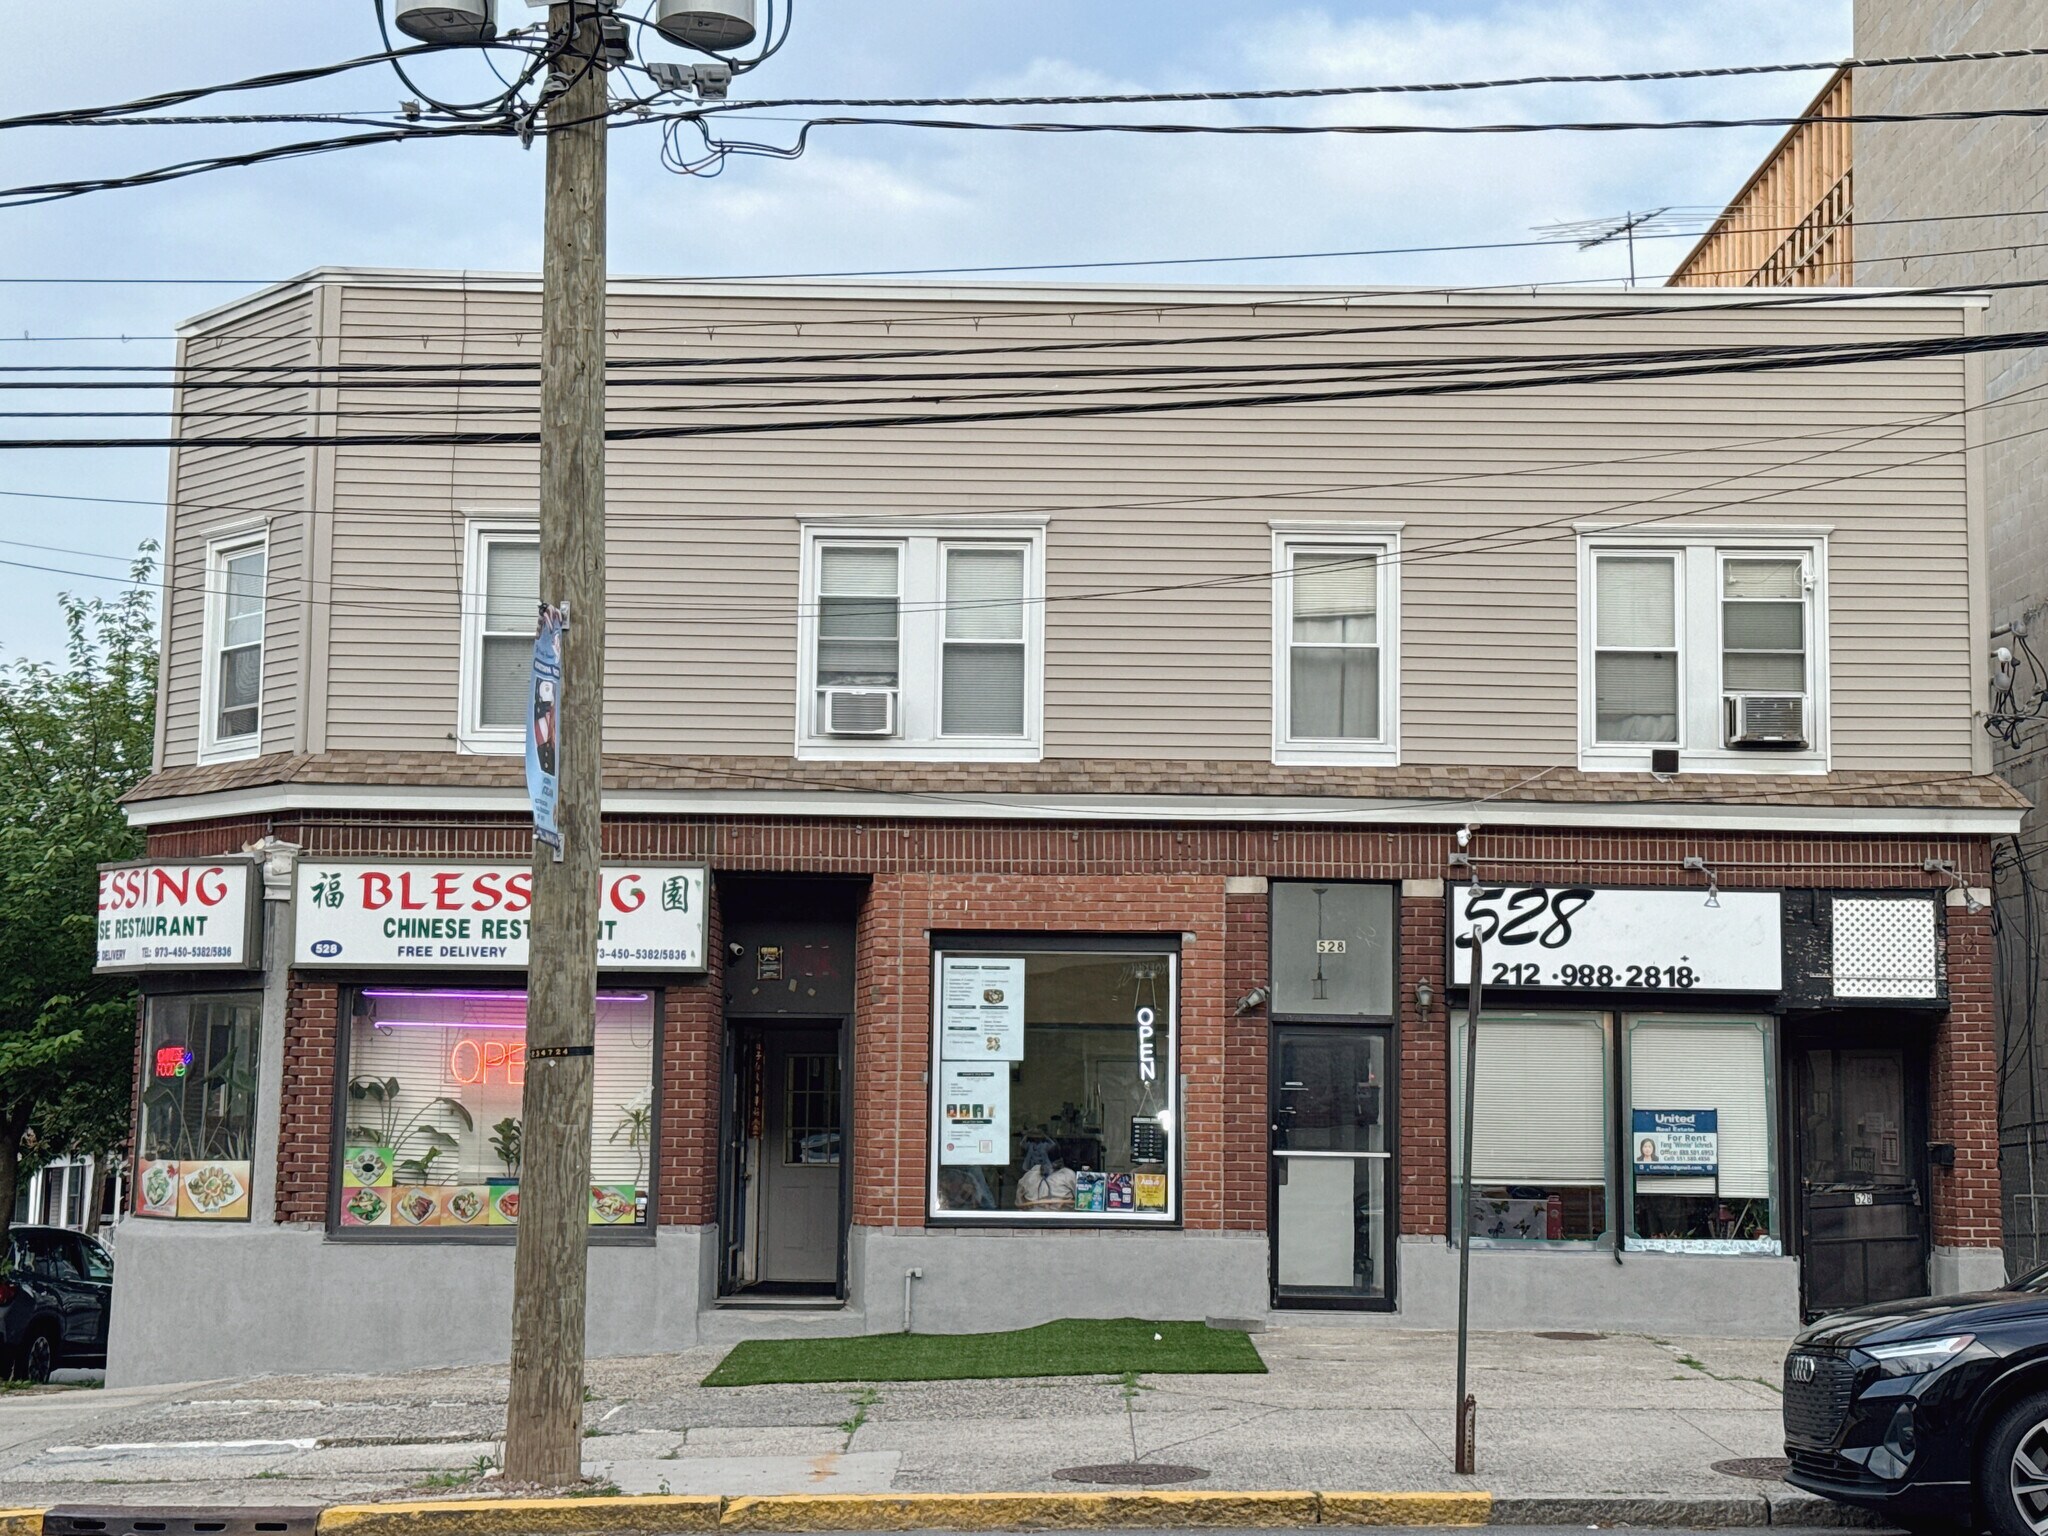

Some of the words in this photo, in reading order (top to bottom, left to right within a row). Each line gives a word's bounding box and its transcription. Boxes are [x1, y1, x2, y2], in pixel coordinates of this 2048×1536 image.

[98, 867, 228, 910] ESSING
[310, 871, 345, 909] 福
[357, 871, 646, 912] BLESSG
[662, 875, 690, 913] 園
[115, 916, 208, 939] RESTAURANT
[383, 917, 470, 939] CHINESE
[1455, 887, 1596, 949] 528
[102, 949, 126, 961] DELIVERY
[154, 946, 232, 958] 973-450-5382/5836
[315, 943, 338, 954] 528
[398, 946, 433, 957] FREE
[441, 946, 507, 958] DELIVERY
[597, 948, 688, 960] 73-450-5382/5836
[1319, 941, 1344, 952] 528
[1492, 963, 1541, 985] 212
[1137, 1007, 1156, 1081] OPEN
[452, 1039, 527, 1084] OPE
[1655, 1114, 1695, 1123] United
[1667, 1134, 1682, 1142] For
[1685, 1134, 1707, 1142] Rent
[1855, 1193, 1872, 1204] 528
